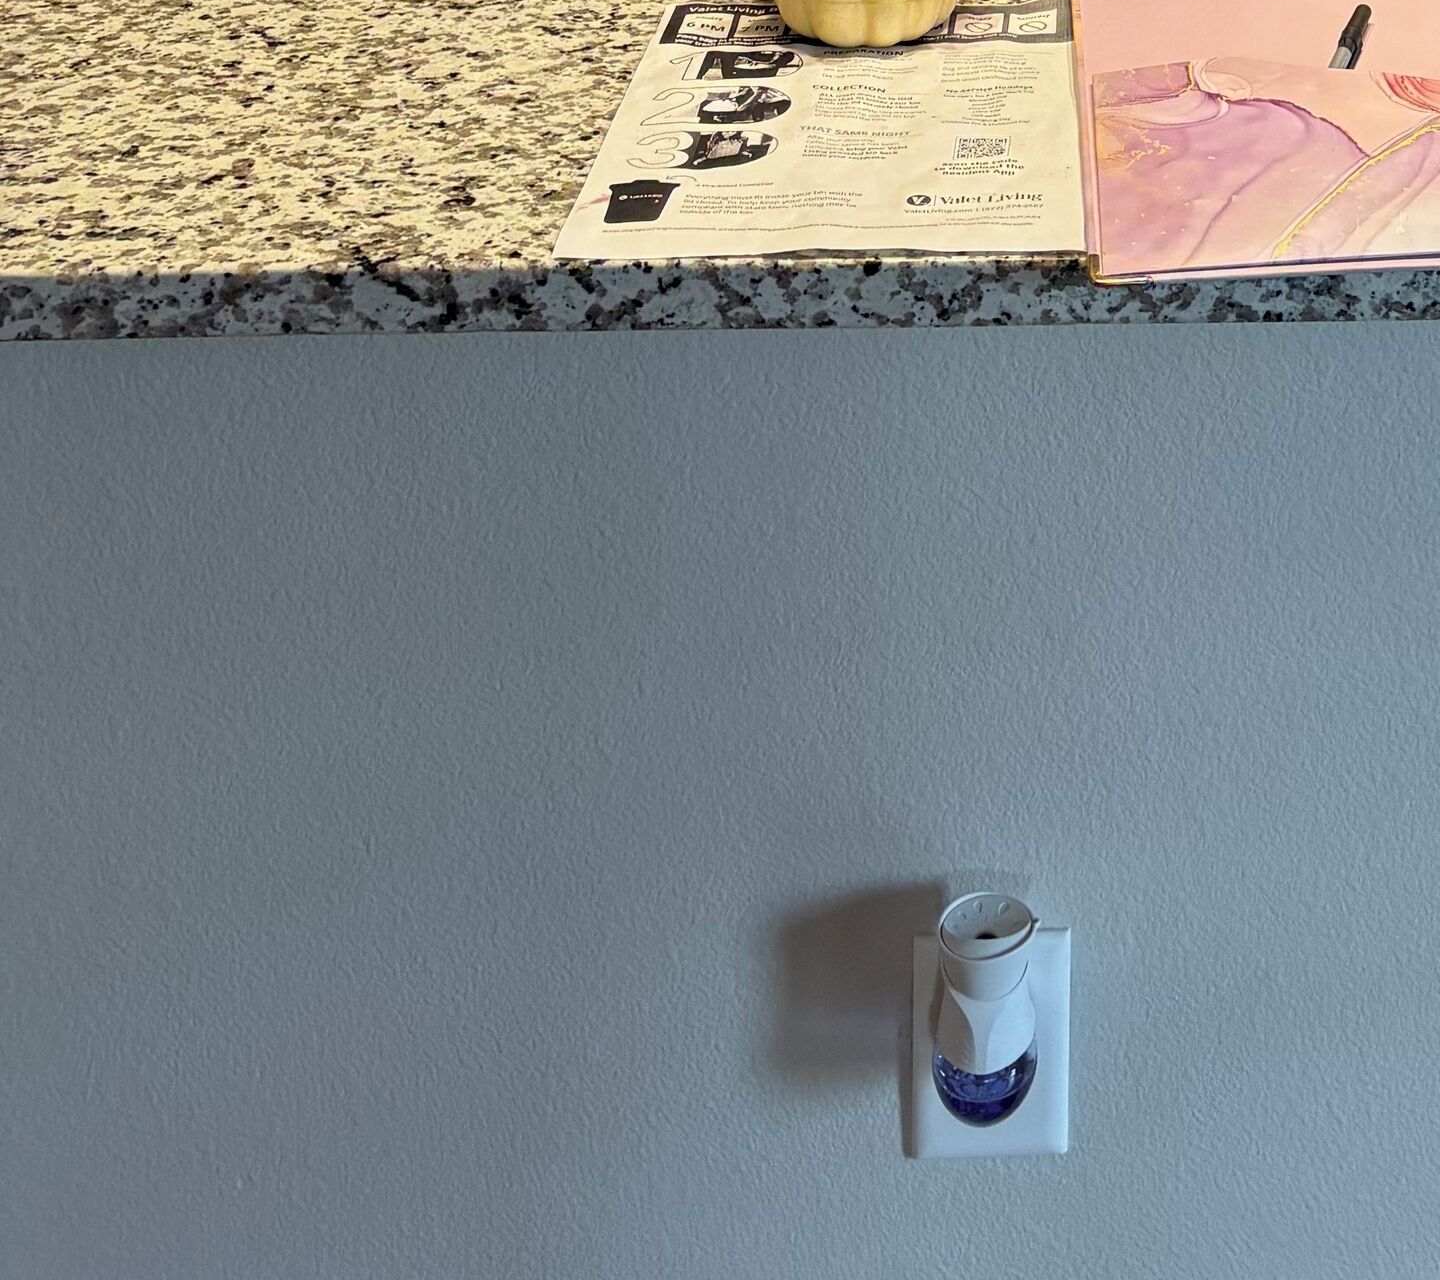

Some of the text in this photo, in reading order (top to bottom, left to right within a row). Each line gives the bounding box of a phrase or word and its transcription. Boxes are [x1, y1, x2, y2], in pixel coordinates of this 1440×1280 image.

[700, 24, 725, 32] PM
[812, 85, 886, 93] COLLECTION
[941, 192, 1043, 205] Valet Living
